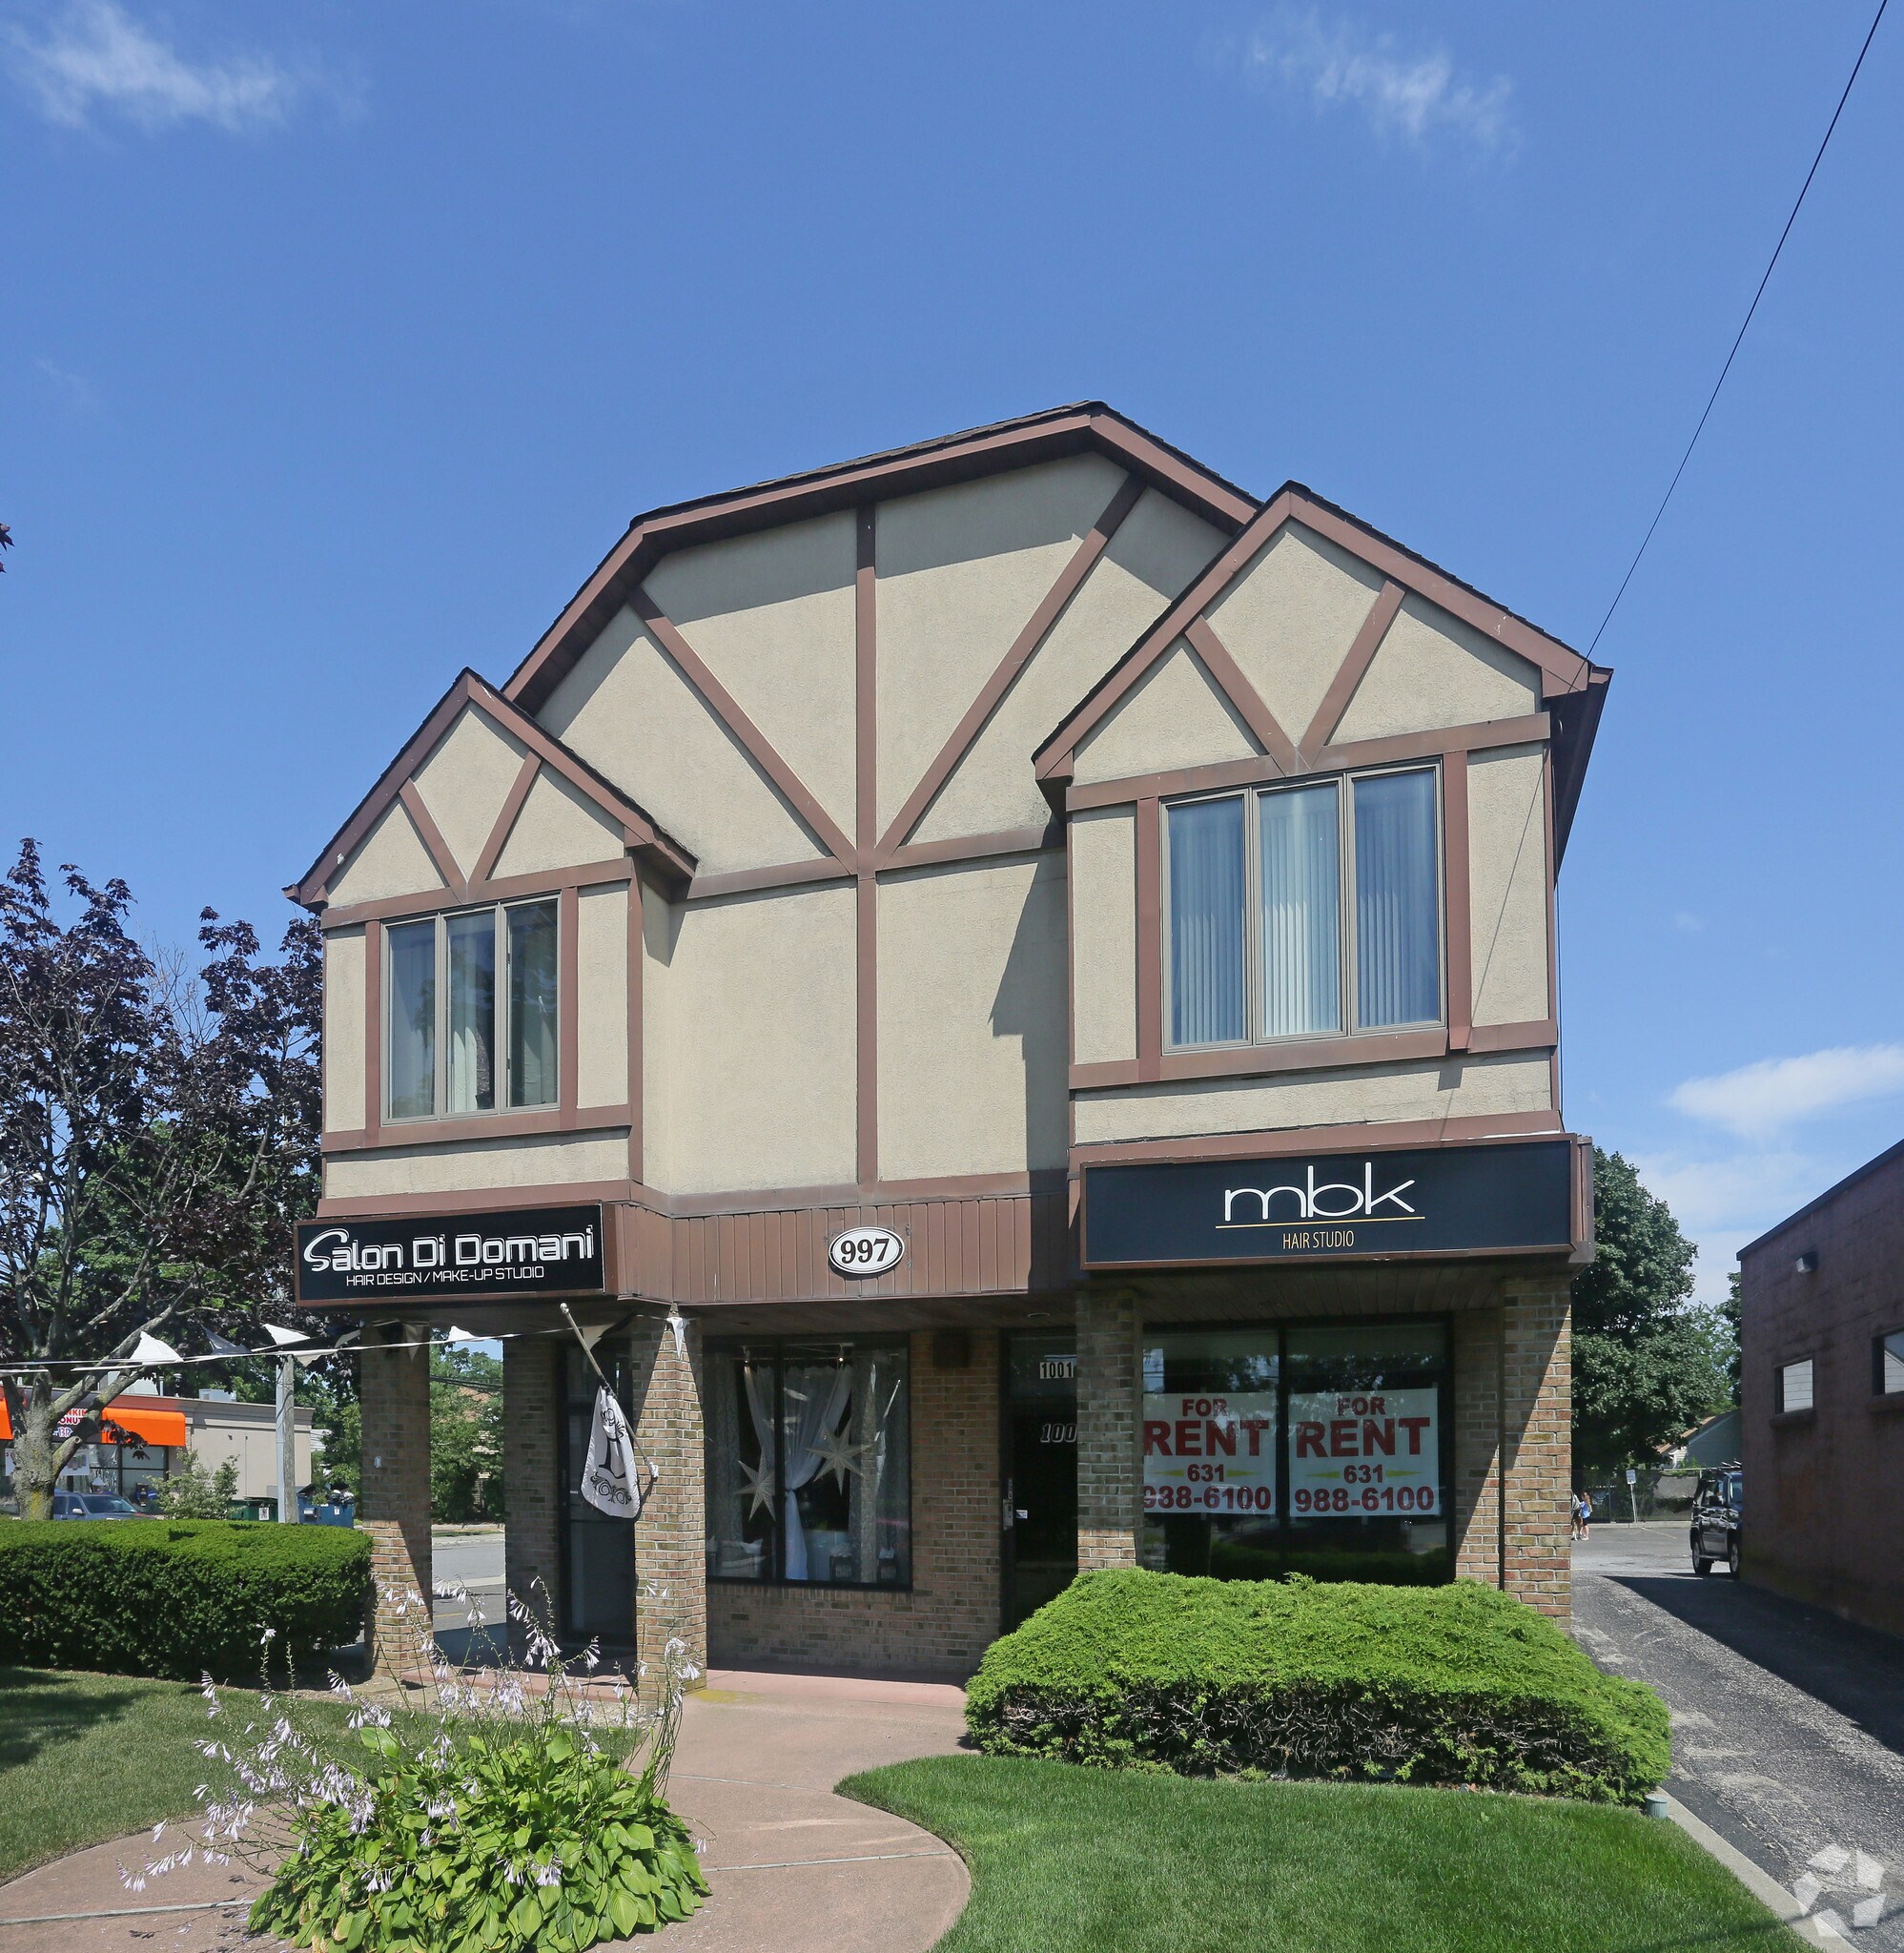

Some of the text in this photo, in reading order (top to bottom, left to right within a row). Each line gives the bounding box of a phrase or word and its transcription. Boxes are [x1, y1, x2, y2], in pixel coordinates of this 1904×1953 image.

[1224, 1162, 1416, 1222] mbk
[303, 1224, 593, 1271] Salon Di Domani
[1282, 1230, 1355, 1249] HAIR STUDIO
[840, 1238, 890, 1264] 997
[346, 1274, 375, 1286] HAIR
[377, 1272, 422, 1285] DESIGN
[432, 1268, 493, 1284] MAKE-UP
[495, 1265, 544, 1280] STUDIO
[1041, 1362, 1074, 1378] 1001
[1182, 1399, 1227, 1416] FOR
[1338, 1397, 1386, 1416] FOR
[1144, 1420, 1269, 1456] RENT
[1296, 1417, 1430, 1458] RENT
[1187, 1464, 1224, 1482] 631
[1343, 1465, 1383, 1484] 631
[1295, 1486, 1434, 1512] 988-6100
